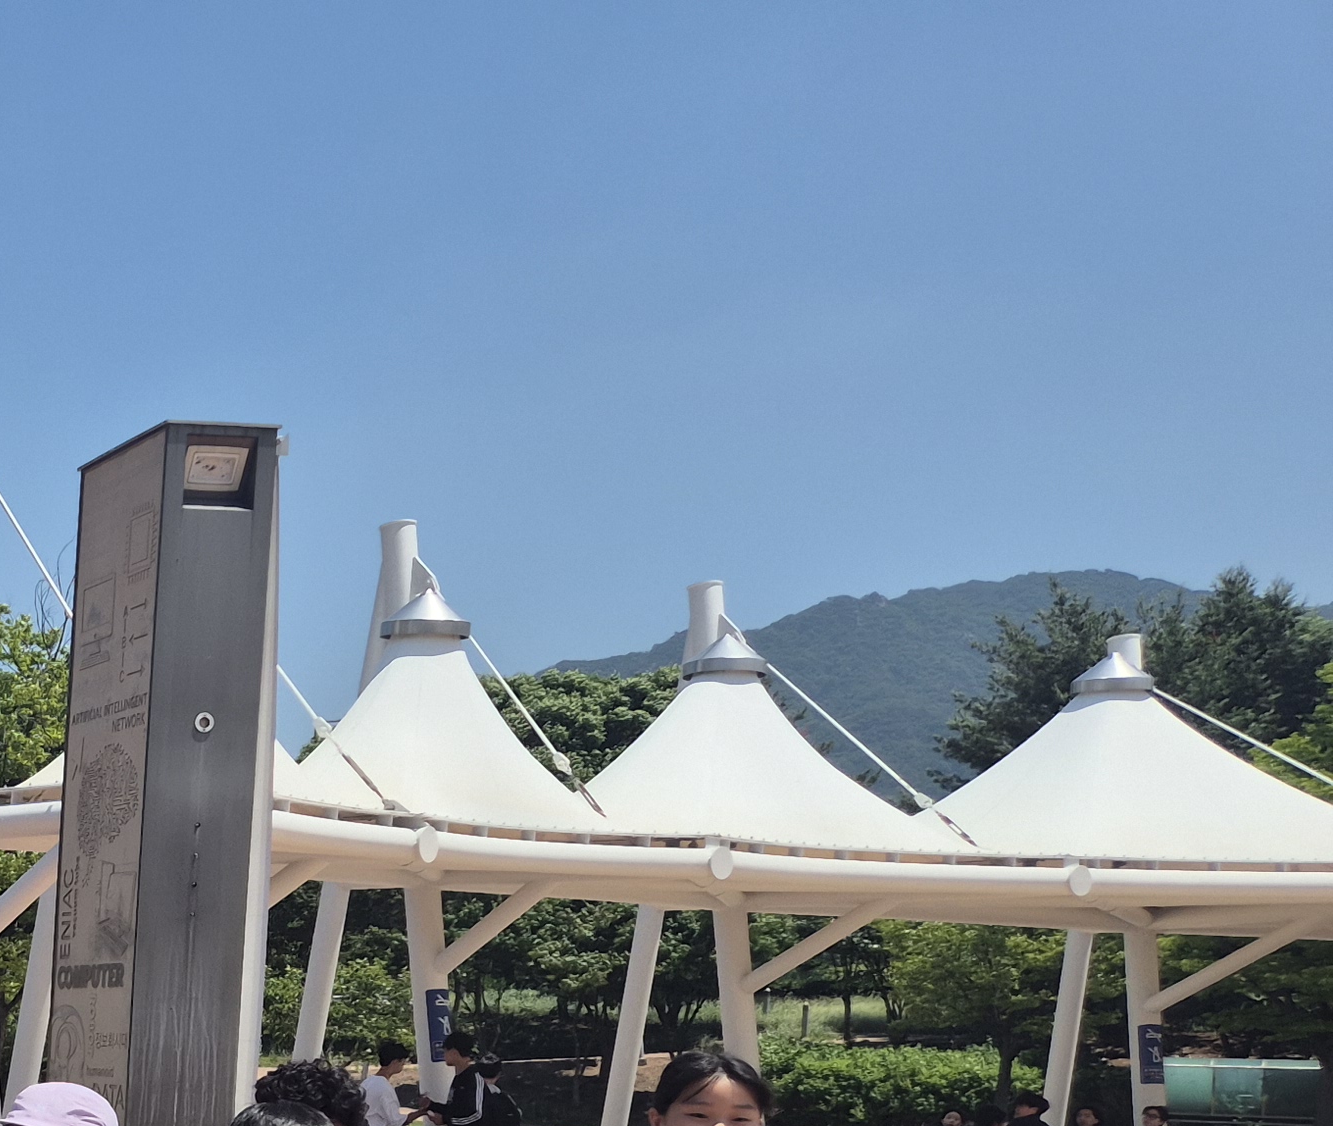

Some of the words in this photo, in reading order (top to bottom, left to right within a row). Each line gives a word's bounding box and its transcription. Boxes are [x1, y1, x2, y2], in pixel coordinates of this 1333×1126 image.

[71, 705, 102, 726] ARTIFICIAL
[111, 712, 146, 733] NETWORK
[59, 868, 74, 960] ENIAC
[57, 962, 125, 990] COMPUTER
[95, 1032, 127, 1049] 정보화시대
